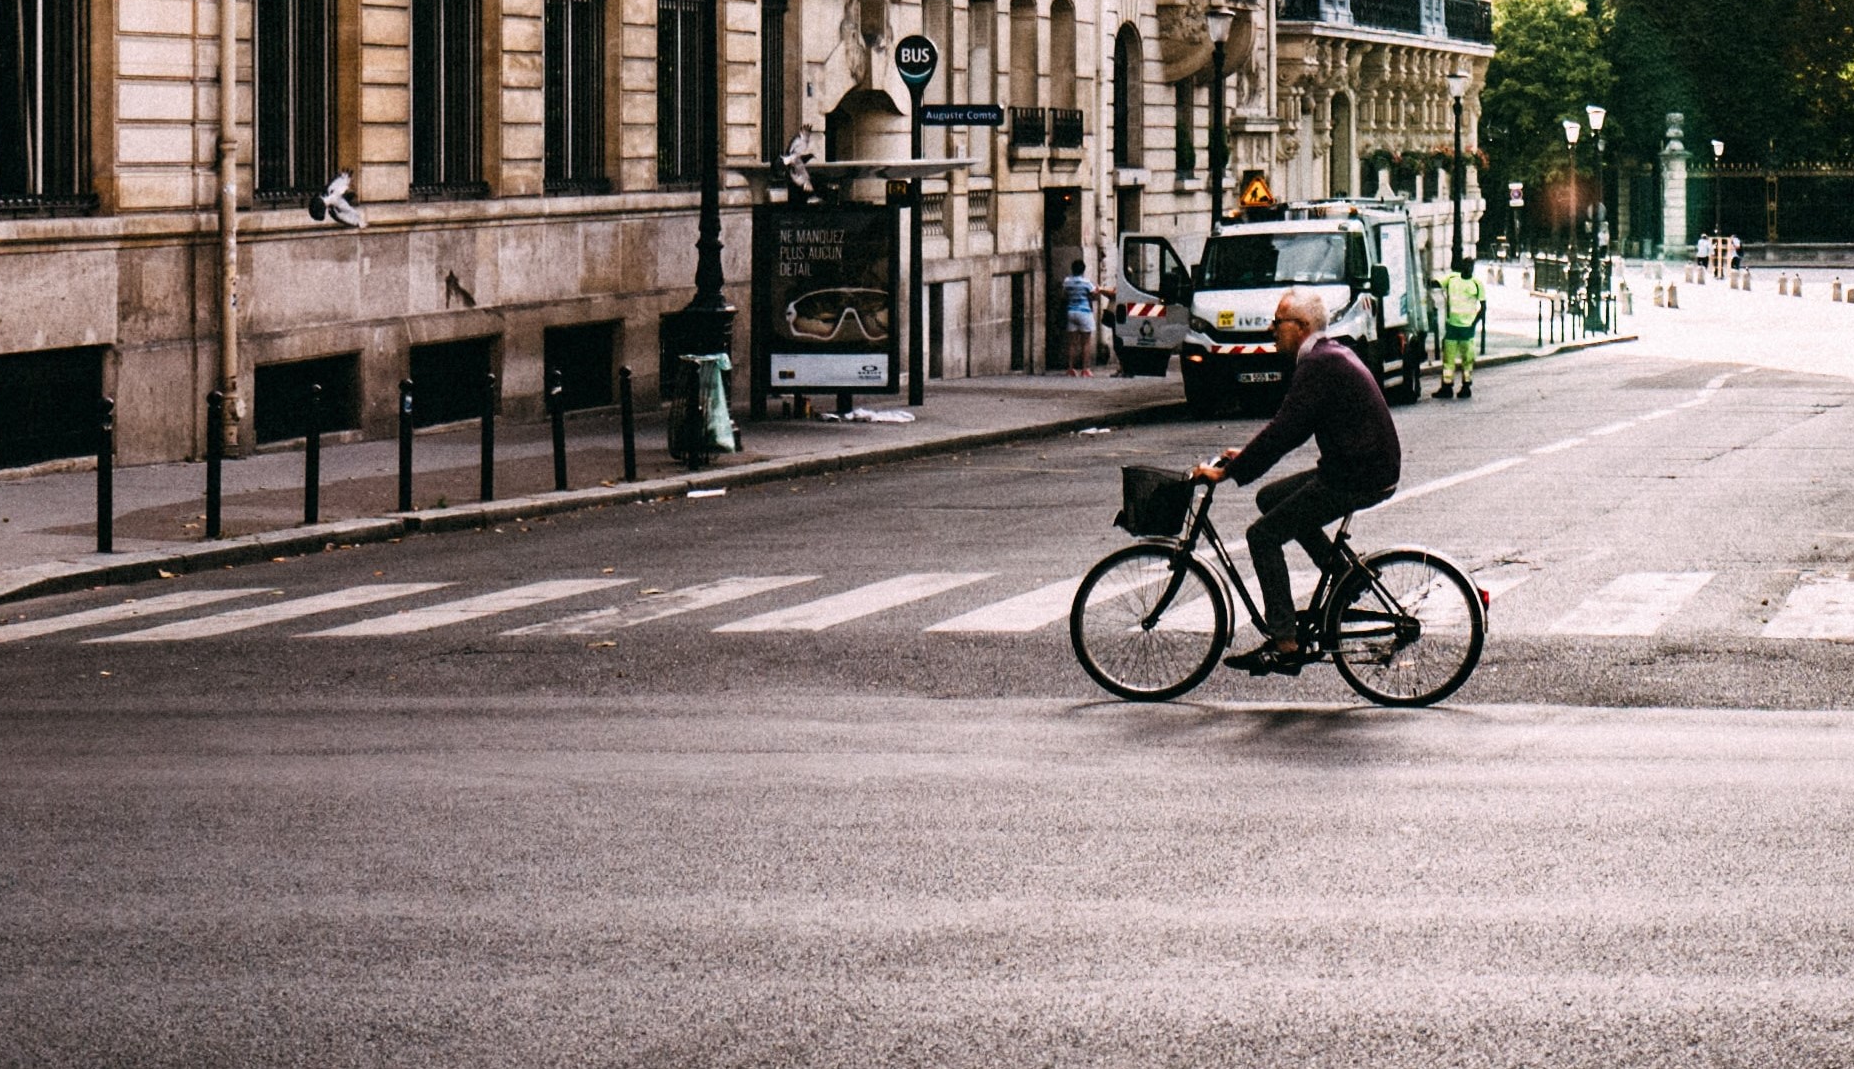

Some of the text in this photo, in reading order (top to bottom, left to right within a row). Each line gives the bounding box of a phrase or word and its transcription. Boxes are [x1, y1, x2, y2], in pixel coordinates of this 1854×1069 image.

[901, 48, 930, 63] BUS
[926, 111, 997, 121] Auguste Comte
[780, 229, 844, 244] NE MANQUEZ
[780, 246, 843, 260] PLUS AUCUN
